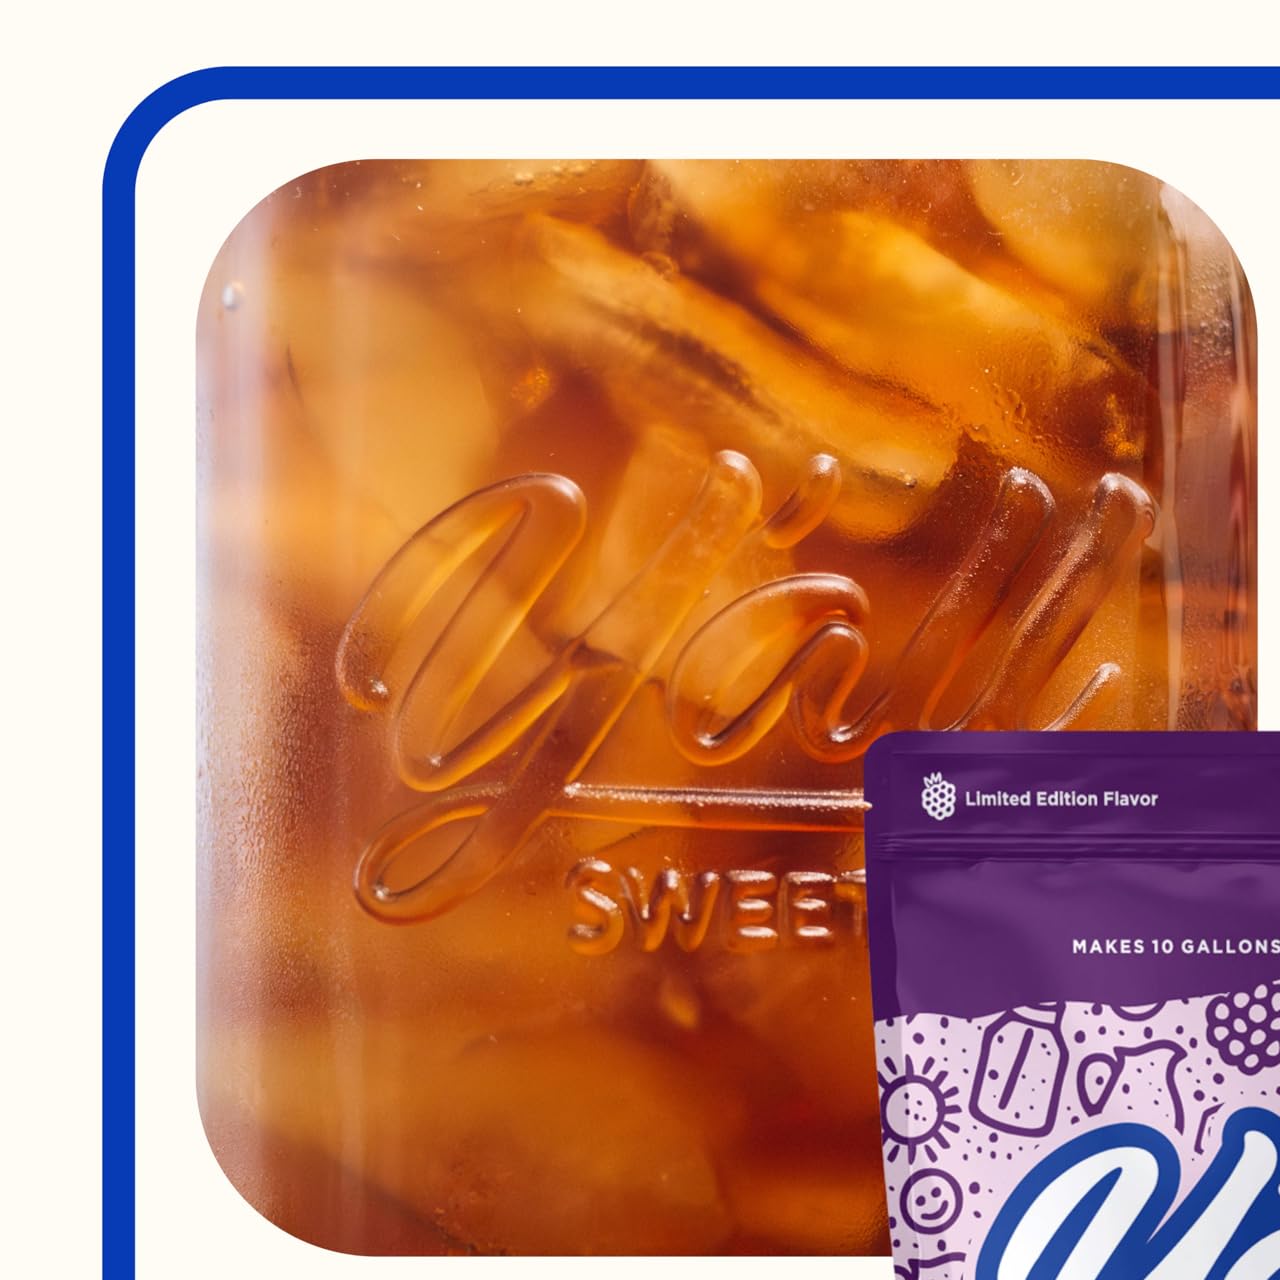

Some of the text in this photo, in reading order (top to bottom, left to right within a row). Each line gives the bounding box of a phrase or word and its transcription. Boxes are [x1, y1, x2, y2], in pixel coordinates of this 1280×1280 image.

[966, 790, 1158, 807] Limited Edition Flavor
[1072, 939, 1145, 954] MAKES
[1152, 939, 1173, 954] 10
